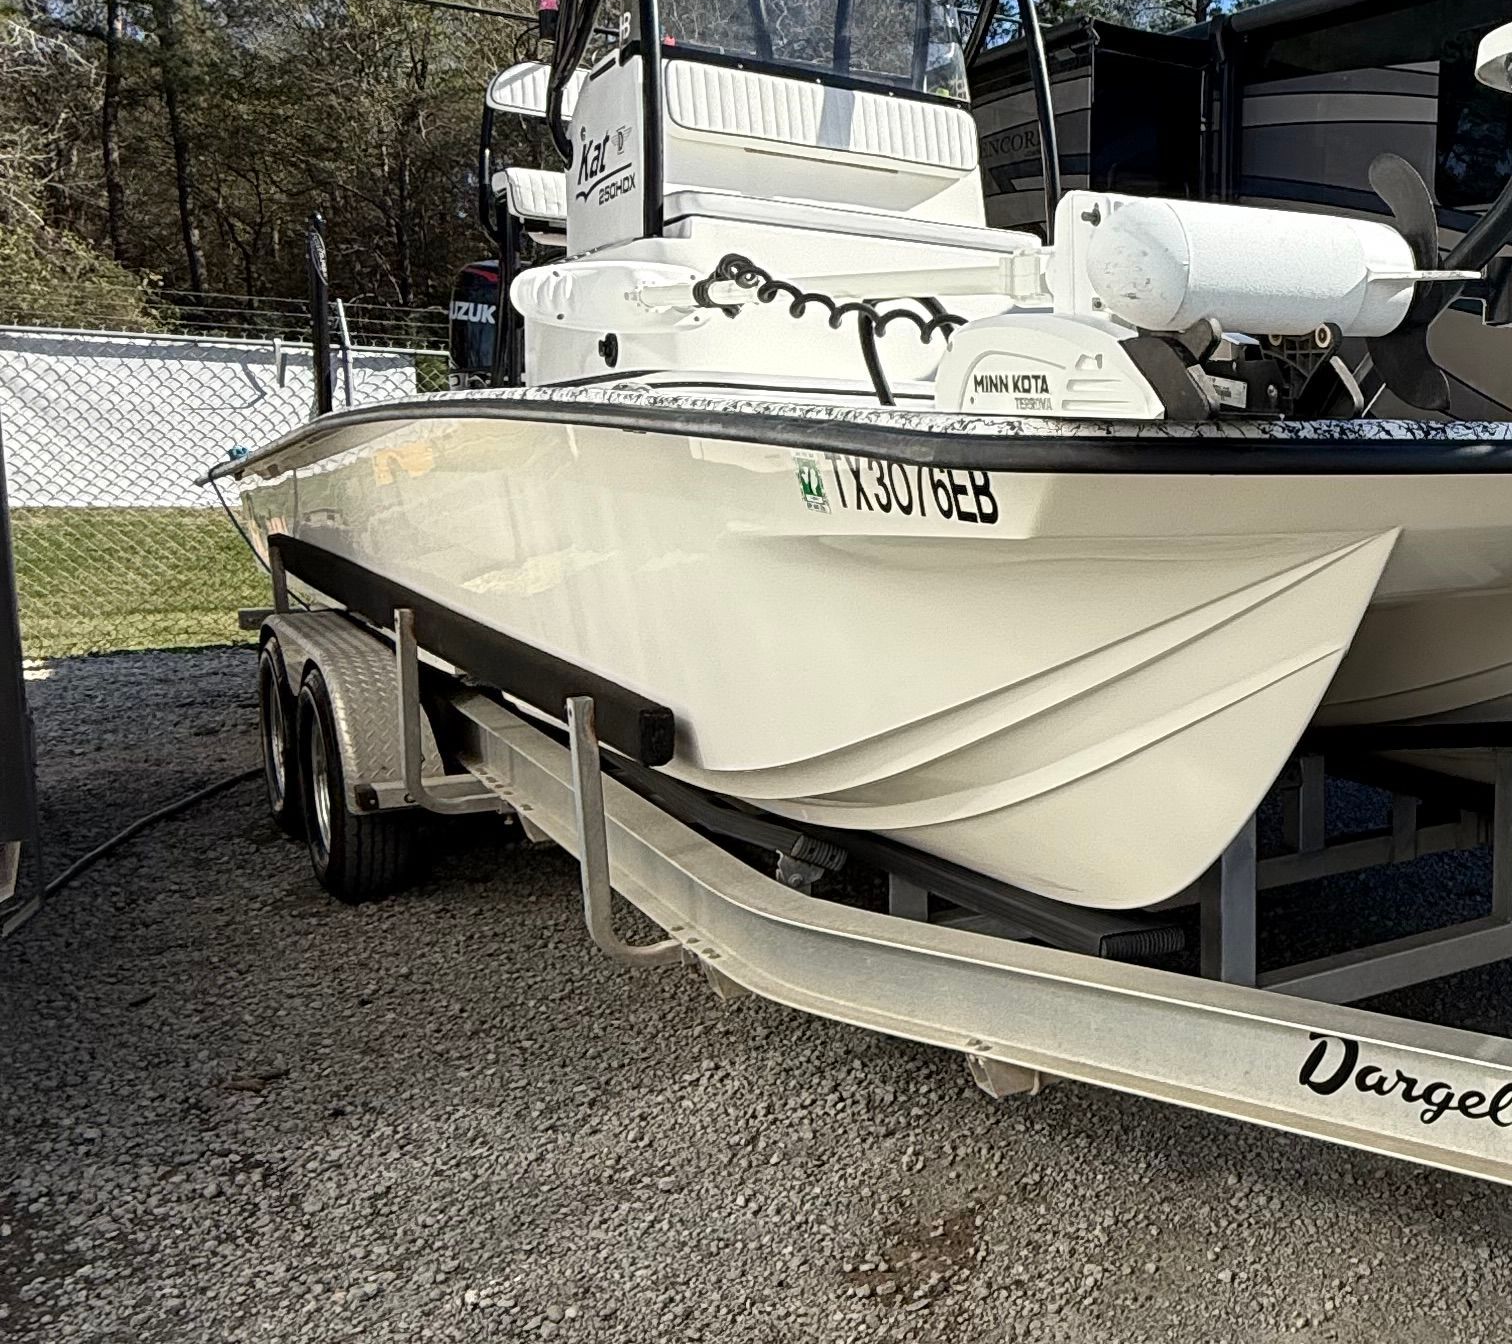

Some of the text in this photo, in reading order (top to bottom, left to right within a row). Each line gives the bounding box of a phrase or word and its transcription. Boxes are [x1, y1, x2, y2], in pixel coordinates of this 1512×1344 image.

[577, 130, 610, 186] Kat
[981, 130, 1041, 158] ENCOR
[598, 172, 636, 206] 250HDX
[449, 301, 497, 324] UZUK
[973, 374, 1050, 395] MINN KOTA
